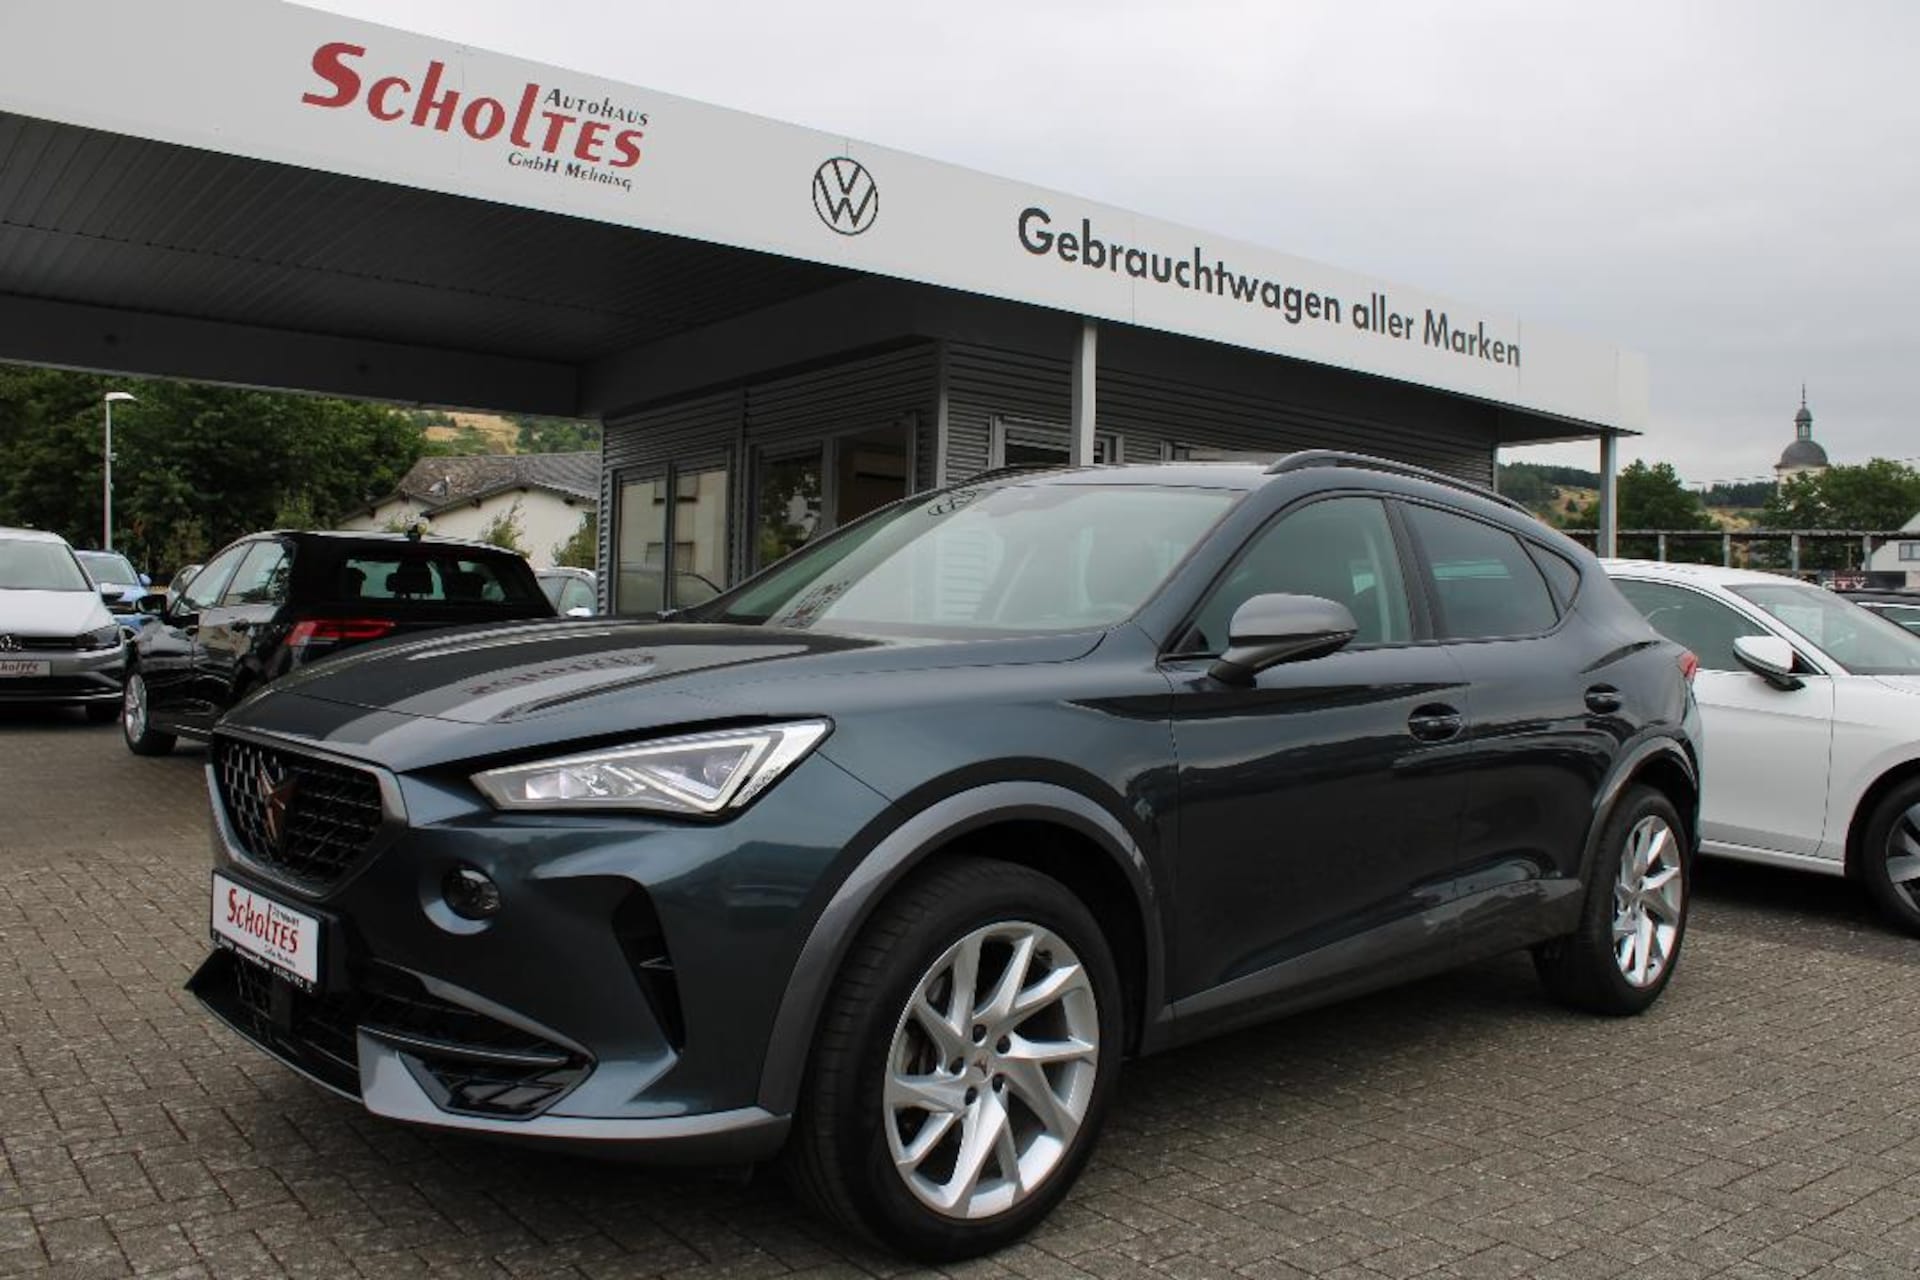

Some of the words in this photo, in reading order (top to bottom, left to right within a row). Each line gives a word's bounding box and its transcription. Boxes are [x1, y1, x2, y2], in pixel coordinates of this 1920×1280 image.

[508, 151, 559, 174] GmbH
[1018, 207, 1341, 325] Gebrauchtwagen
[1352, 292, 1414, 341] aller
[1423, 308, 1520, 367] Marken
